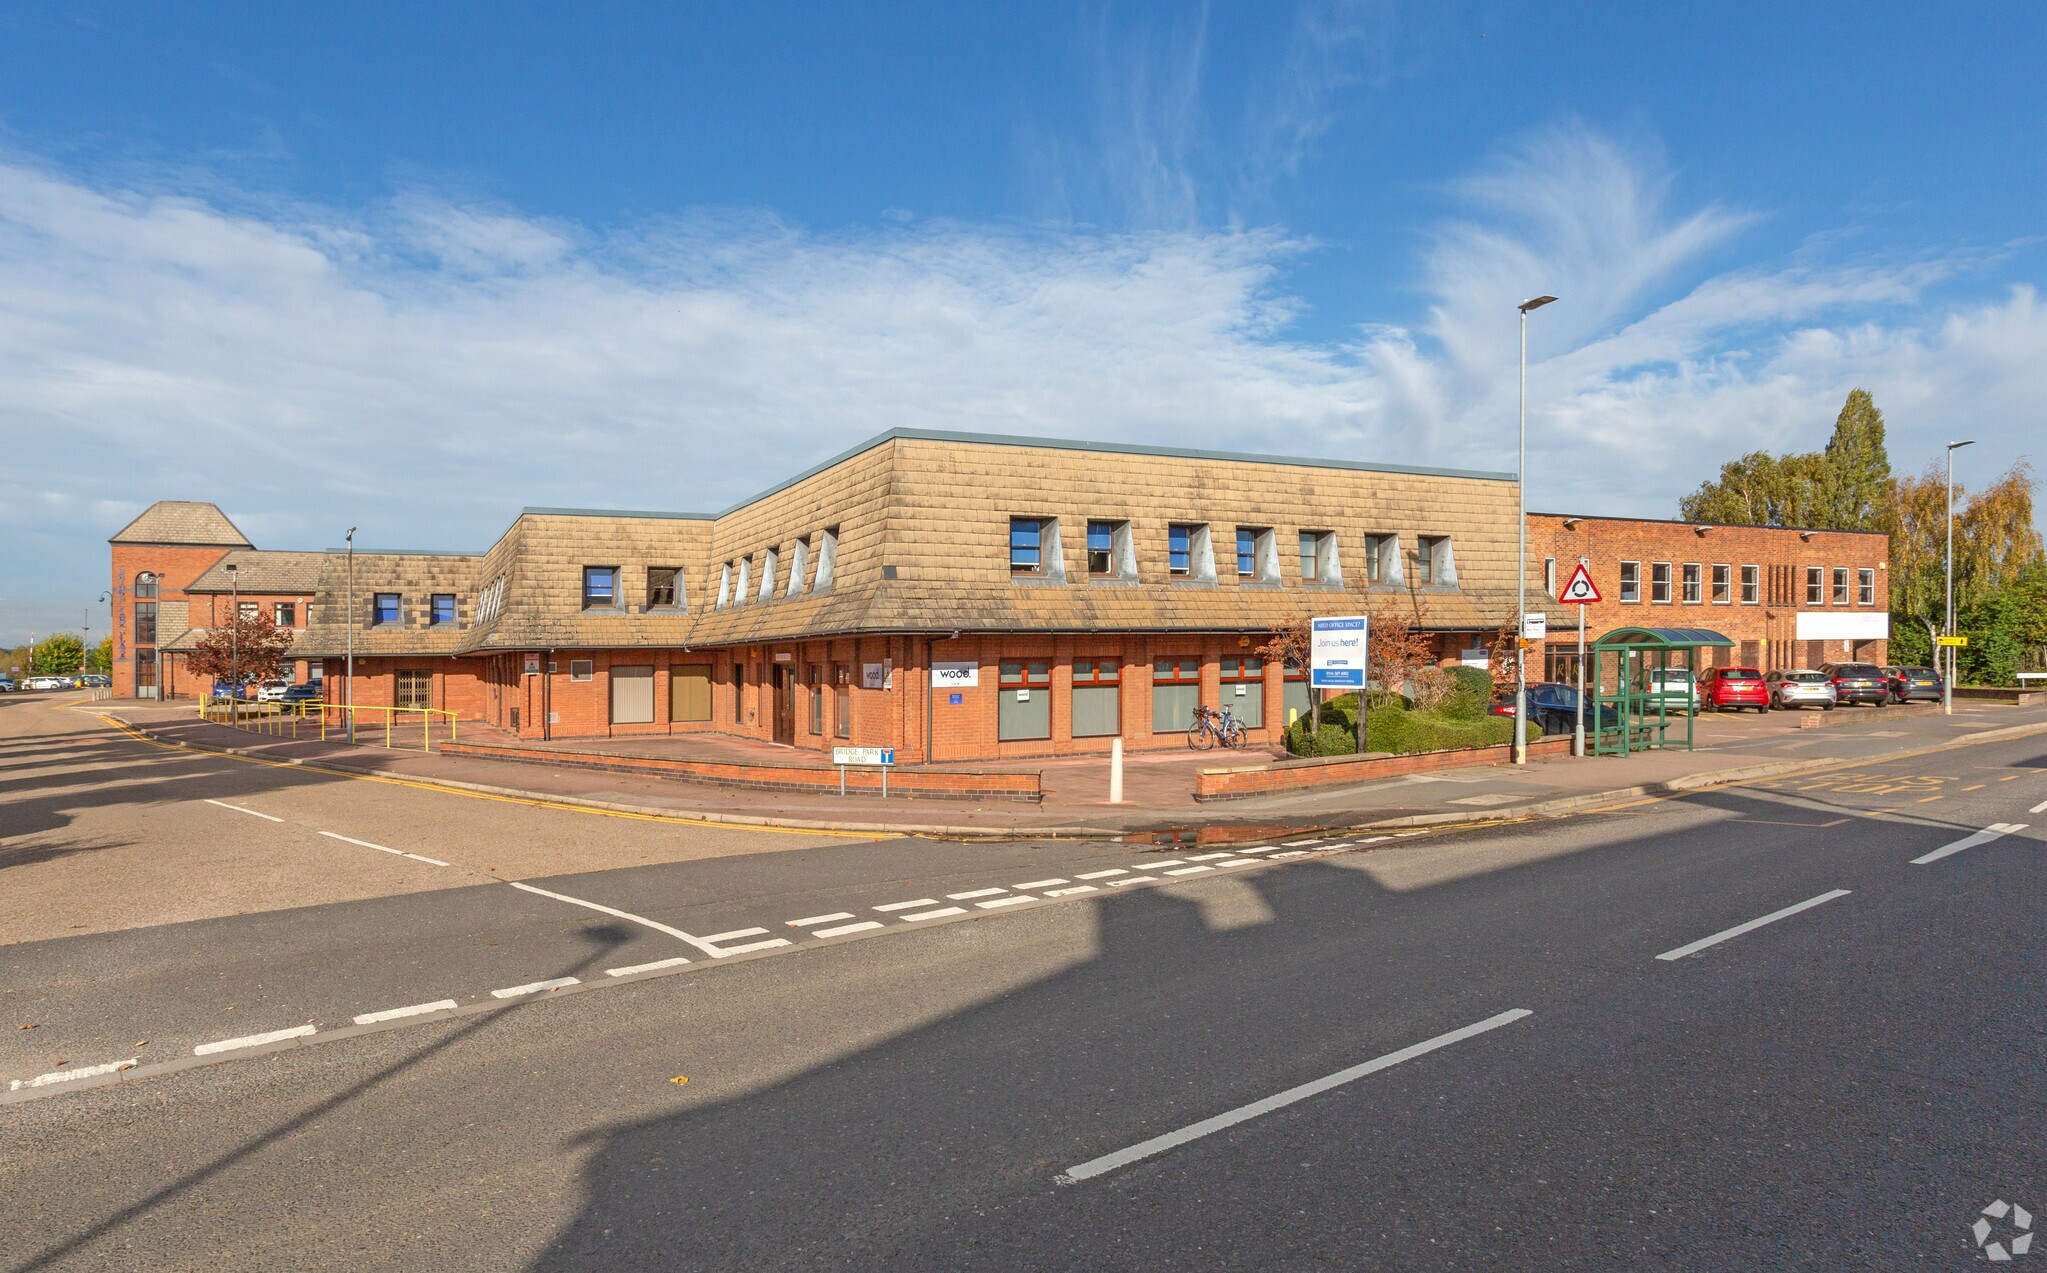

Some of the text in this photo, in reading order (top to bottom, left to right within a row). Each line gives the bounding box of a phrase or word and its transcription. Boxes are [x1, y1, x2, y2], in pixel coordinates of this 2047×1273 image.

[1318, 638, 1330, 648] Join
[1340, 638, 1358, 647] here!
[1807, 773, 1960, 785] BUS
